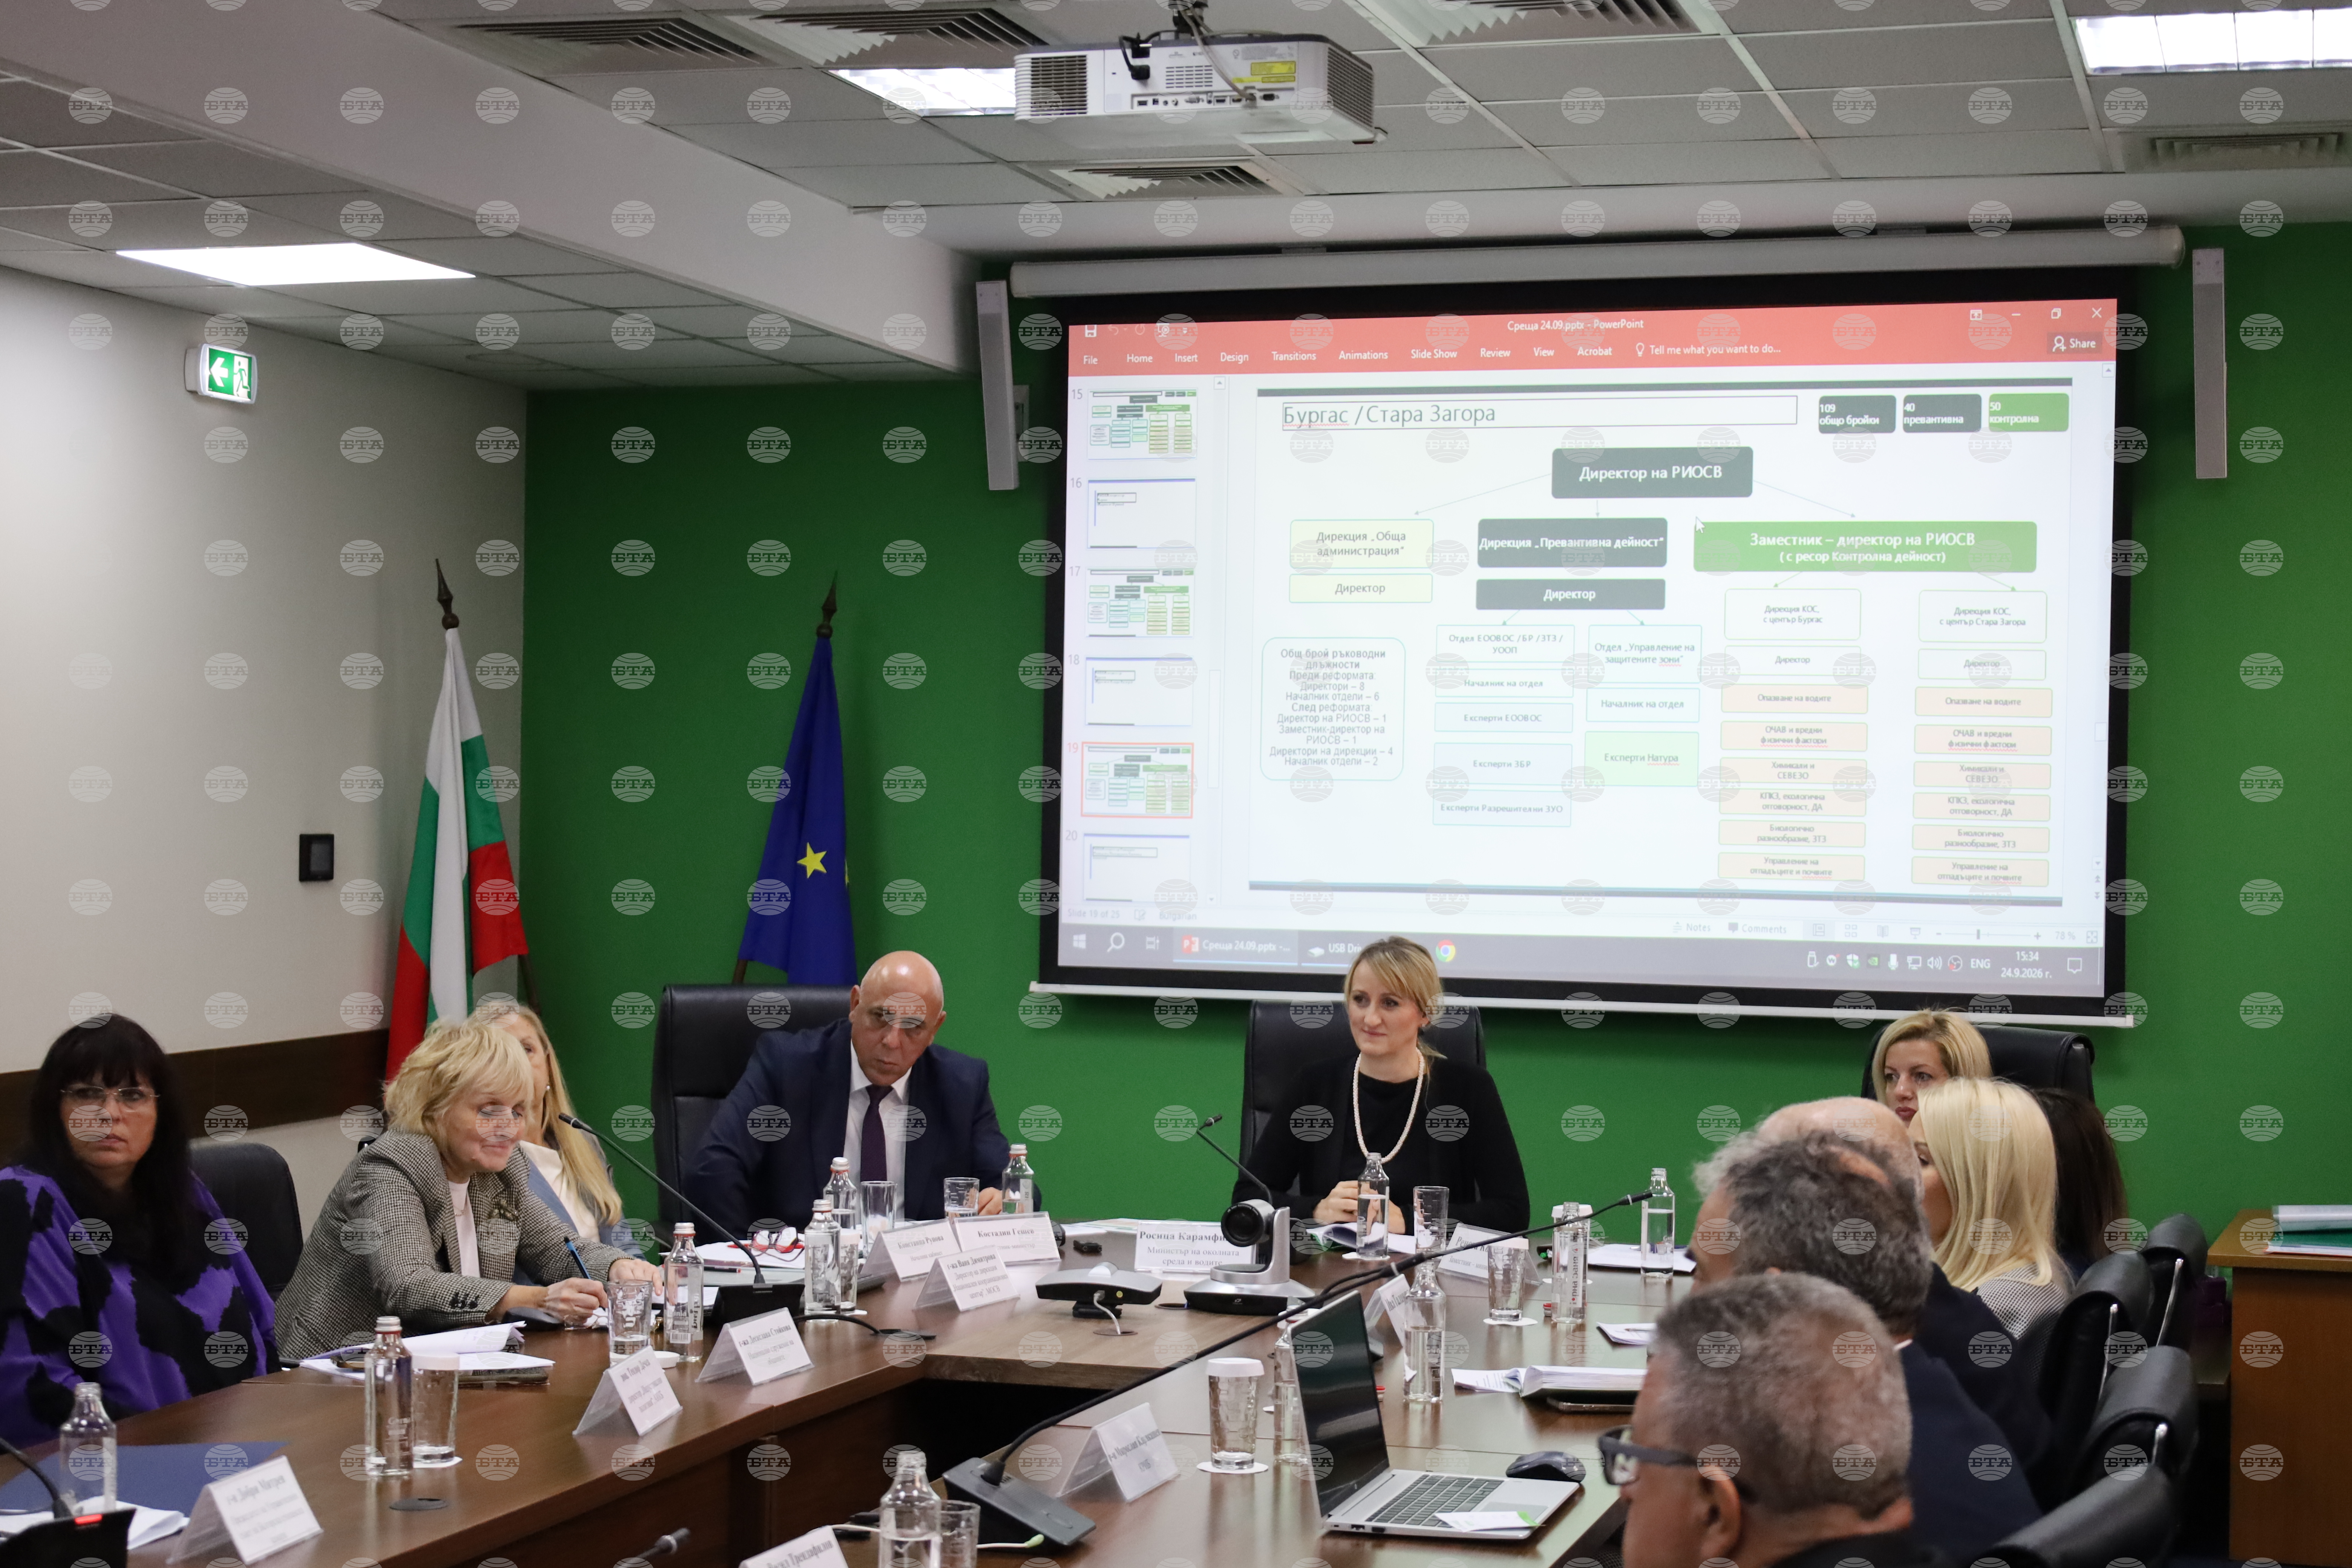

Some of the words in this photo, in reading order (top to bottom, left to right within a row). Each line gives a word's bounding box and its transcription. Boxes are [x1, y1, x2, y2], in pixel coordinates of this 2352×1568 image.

[1507, 320, 1538, 332] Среща
[1540, 320, 1584, 332] 24.09.pptx
[1594, 318, 1644, 329] PowerPoint
[2070, 338, 2096, 348] Share
[1339, 350, 1388, 360] Animations
[1411, 349, 1430, 359] Slide
[1433, 349, 1457, 358] Show
[1481, 348, 1510, 358] Review
[1534, 347, 1554, 357] View
[1577, 346, 1612, 356] Acrobat
[1650, 345, 1664, 354] Tell
[1683, 345, 1704, 354] what
[1706, 347, 1724, 356] you
[1762, 344, 1781, 353] do...
[1084, 355, 1098, 365] File
[1127, 354, 1153, 363] Home
[1175, 353, 1198, 362] Insert
[1220, 352, 1249, 364] Design
[1272, 351, 1317, 361] Transitions
[1072, 389, 1083, 400] 15
[1820, 404, 1835, 413] 109
[1904, 403, 1915, 412] 40
[1989, 402, 2001, 411] 50
[1284, 407, 1348, 429] Бургас
[1430, 405, 1495, 426] Загора
[1819, 416, 1844, 426] общо
[1847, 415, 1879, 427] бройки
[1904, 415, 1963, 425] превантивна
[1989, 415, 2039, 425] контролна
[1579, 467, 1647, 481] Директор
[1652, 470, 1667, 478] на
[1672, 465, 1721, 478] РИОСВ
[1071, 478, 1082, 488] 16
[1316, 532, 1367, 543] Дирекция
[1750, 533, 1822, 545] Заместник
[1837, 535, 1902, 548] директор
[1905, 536, 1921, 545] на
[1926, 533, 1975, 545] РИОСВ
[1479, 538, 1531, 550] Дирекция
[1796, 553, 1830, 564] ресор
[1832, 552, 1892, 564] Контролна
[1894, 551, 1946, 564] дейност)
[1070, 566, 1080, 576] 17
[1335, 584, 1385, 595] Директор
[1543, 589, 1596, 601] Директор
[1764, 605, 1800, 614] Дирекция
[1954, 608, 1990, 616] Дирекция
[2000, 619, 2026, 627] Загора
[1595, 643, 1621, 652] Отдел
[1281, 649, 1302, 658] Общ
[1306, 649, 1329, 658] брой
[1332, 651, 1385, 659] ръководни
[1068, 654, 1080, 665] 18
[1605, 656, 1657, 665] защитените
[1306, 661, 1360, 670] длъжности
[1289, 671, 1319, 680] Преди
[1323, 671, 1376, 680] реформата:
[1300, 682, 1348, 692] Директори
[1360, 682, 1364, 691] 8
[1292, 703, 1316, 712] След
[1319, 703, 1372, 712] реформата:
[1658, 701, 1684, 709] отдел
[1277, 714, 1319, 724] Директор
[1336, 714, 1370, 722] РИОСВ
[1382, 714, 1386, 722] 1
[1067, 743, 1078, 753] 19
[1604, 753, 1645, 763] Експерти
[1648, 754, 1678, 763] Натура
[1066, 830, 1077, 841] 20
[1686, 923, 1710, 932] Notes
[1742, 924, 1786, 934] Comments
[2055, 931, 2065, 940] 78
[1203, 940, 1233, 951] Среща
[1235, 940, 1276, 952] 24.09.pptx
[1329, 943, 1345, 952] USB
[2016, 951, 2039, 961] 15:34
[1971, 959, 1990, 969] ENG
[2001, 968, 2043, 978] 24.9.2026
[1140, 1231, 1174, 1239] Росица
[1179, 1232, 1228, 1243] Карамфи
[1147, 1246, 1188, 1256] Министър
[970, 1254, 996, 1265] Димитрова
